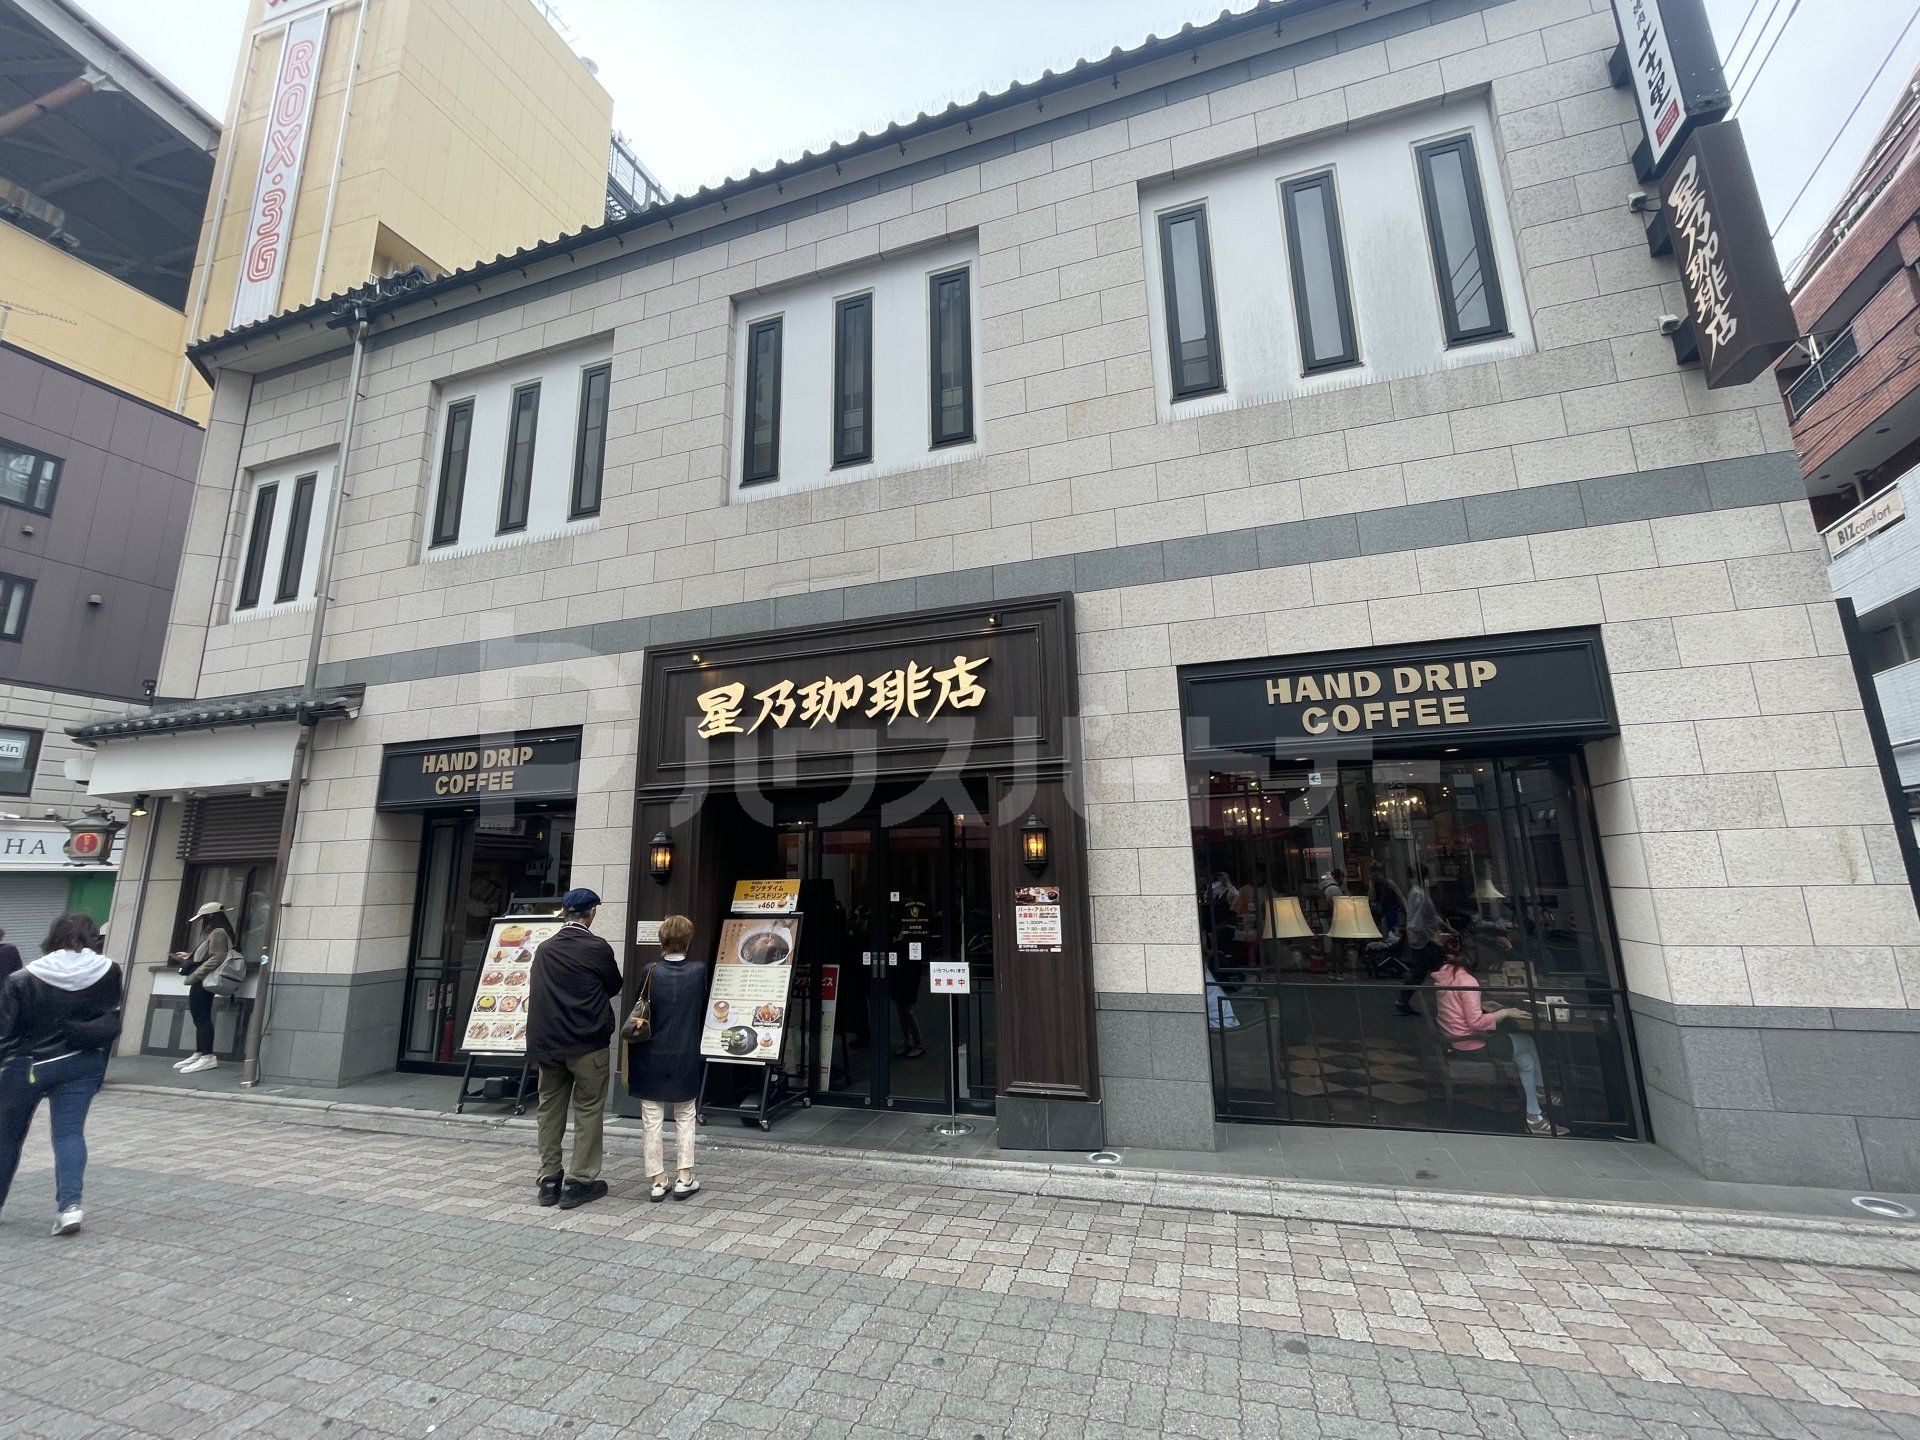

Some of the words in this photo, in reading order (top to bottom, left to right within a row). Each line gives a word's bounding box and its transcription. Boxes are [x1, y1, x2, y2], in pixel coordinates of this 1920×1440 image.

[1667, 155, 1738, 371] 星乃珈琲店
[697, 655, 990, 739] 星乃珈琲店
[1266, 671, 1382, 705] HAND
[1393, 660, 1498, 694] DRIP
[1302, 696, 1470, 735] COFFEE
[422, 751, 478, 773] HAND
[483, 746, 533, 769] DRIP
[435, 770, 514, 795] COFFEE
[934, 978, 966, 987] 営業中
